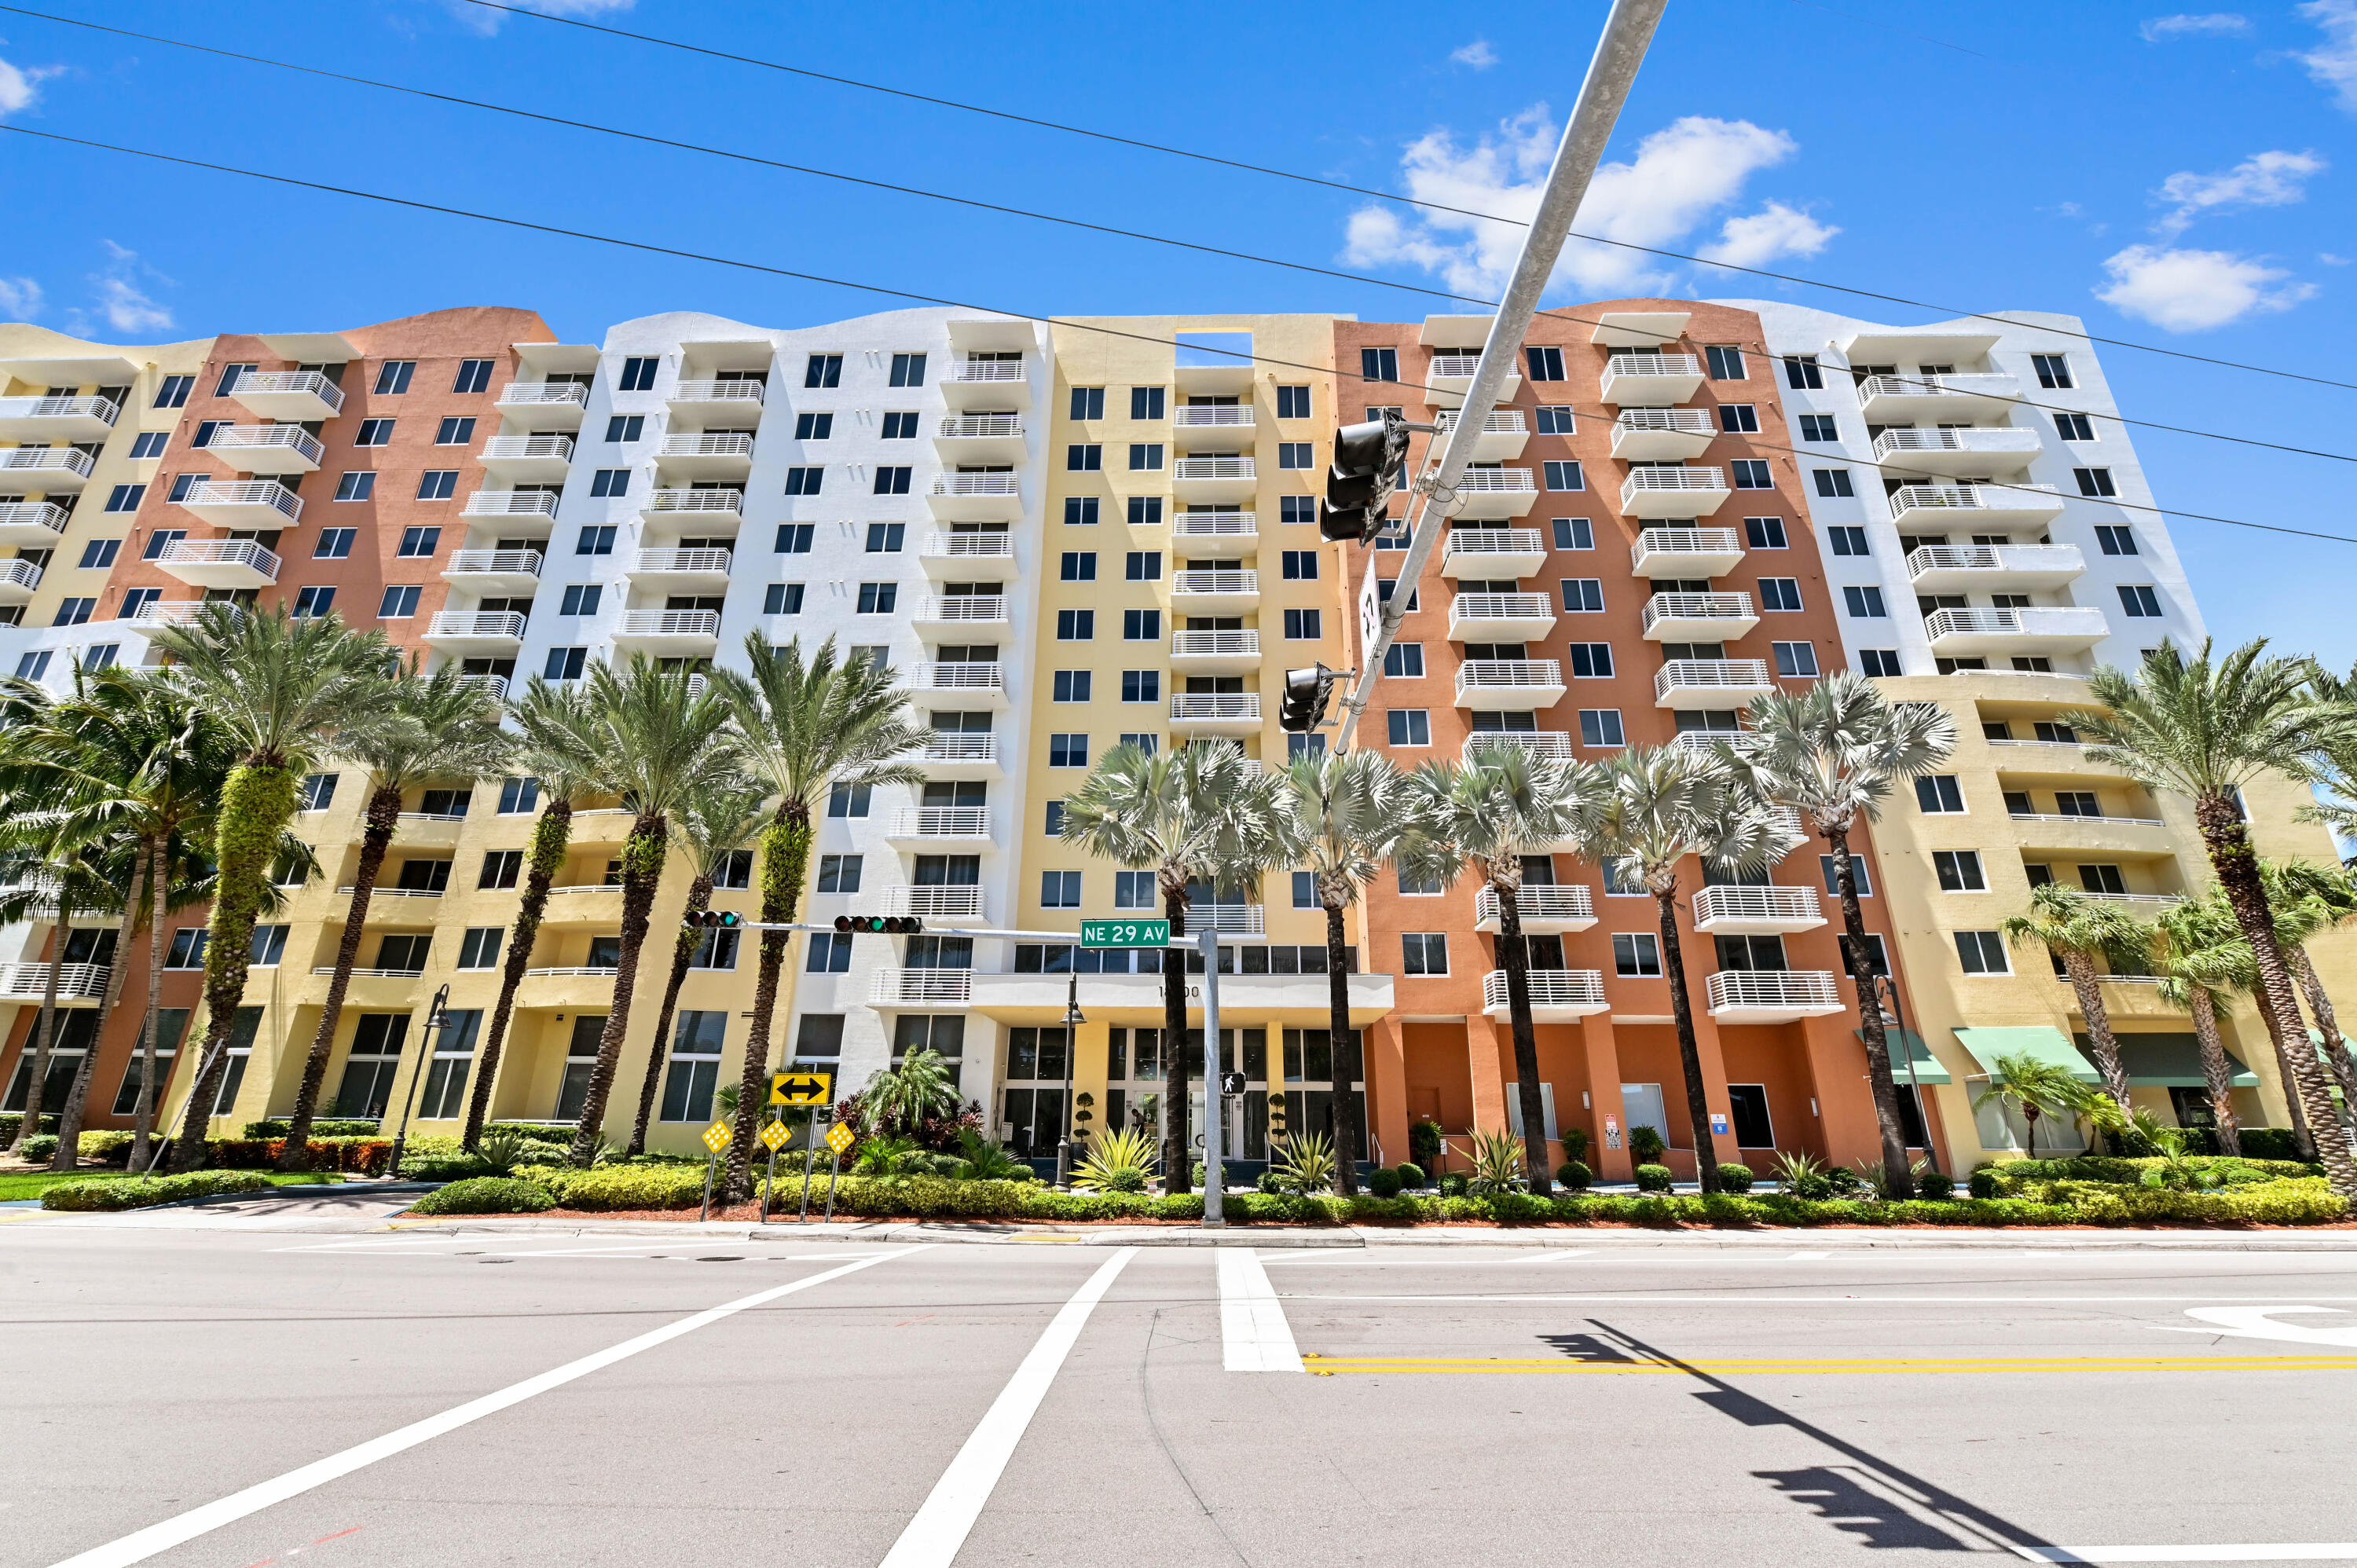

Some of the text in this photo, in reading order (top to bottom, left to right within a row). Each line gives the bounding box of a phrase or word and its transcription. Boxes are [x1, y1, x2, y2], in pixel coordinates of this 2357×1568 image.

[1085, 925, 1165, 942] NE 29 AV
